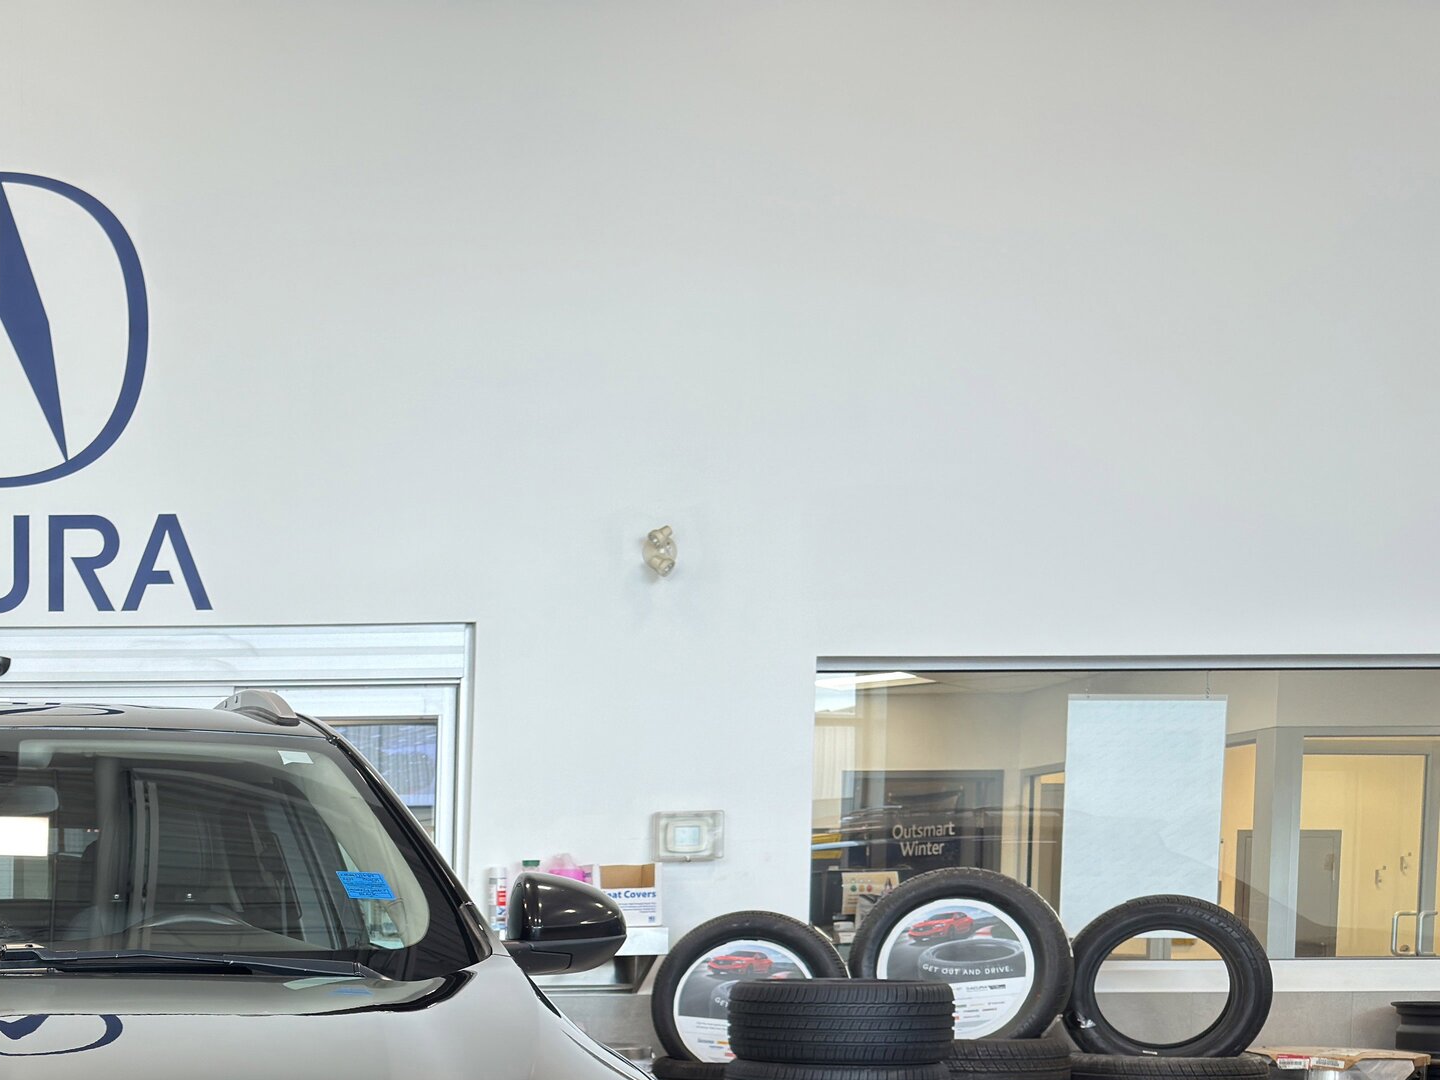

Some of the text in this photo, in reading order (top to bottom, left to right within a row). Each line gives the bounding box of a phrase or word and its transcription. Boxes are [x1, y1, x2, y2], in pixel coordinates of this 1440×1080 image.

[892, 822, 956, 840] Outsmart
[900, 841, 945, 857] Winter
[623, 890, 657, 899] Covers
[922, 963, 1014, 976] GET OUT AND DRIVE.
